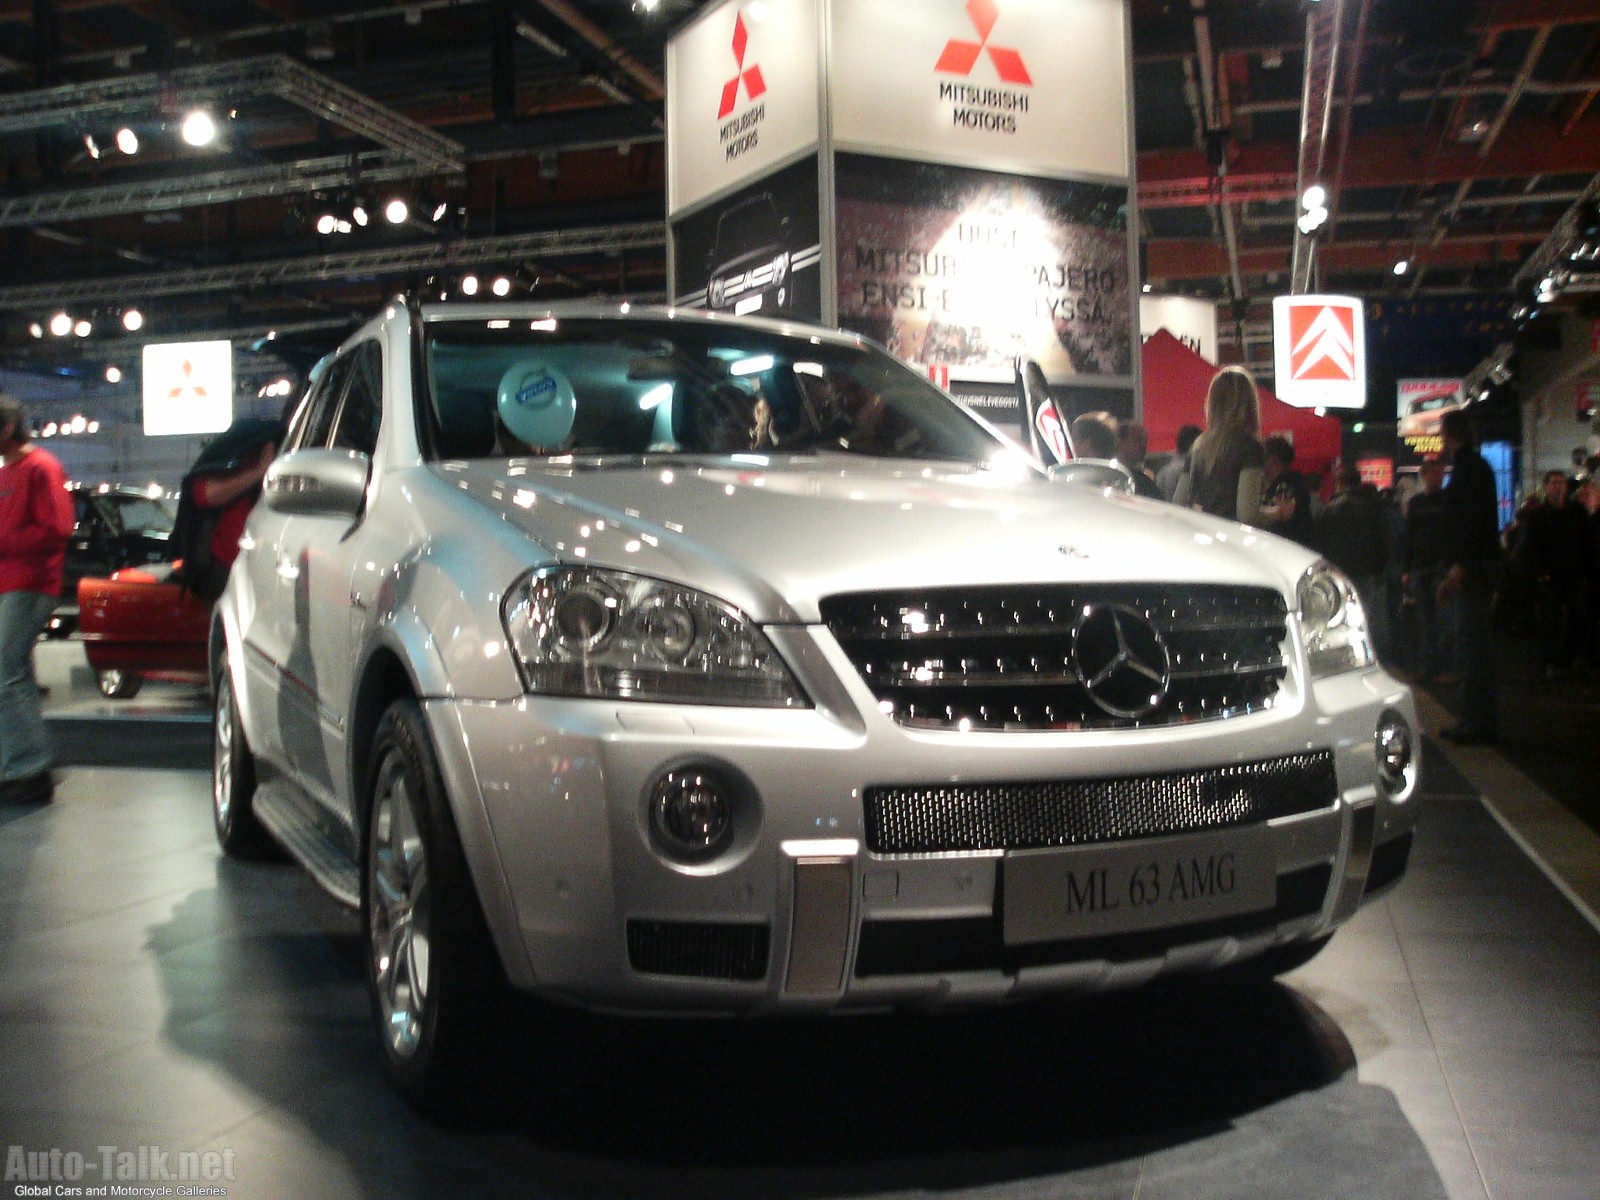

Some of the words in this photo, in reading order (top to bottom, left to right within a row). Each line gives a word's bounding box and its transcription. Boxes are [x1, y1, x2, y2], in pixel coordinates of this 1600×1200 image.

[939, 81, 1029, 112] MITSUBISHI
[719, 103, 765, 144] MITSUBISHI
[953, 107, 1016, 133] MOTORS
[726, 128, 758, 163] MOTORS
[1065, 867, 1119, 914] ML
[1128, 862, 1161, 909] 63
[1168, 852, 1236, 902] AMG
